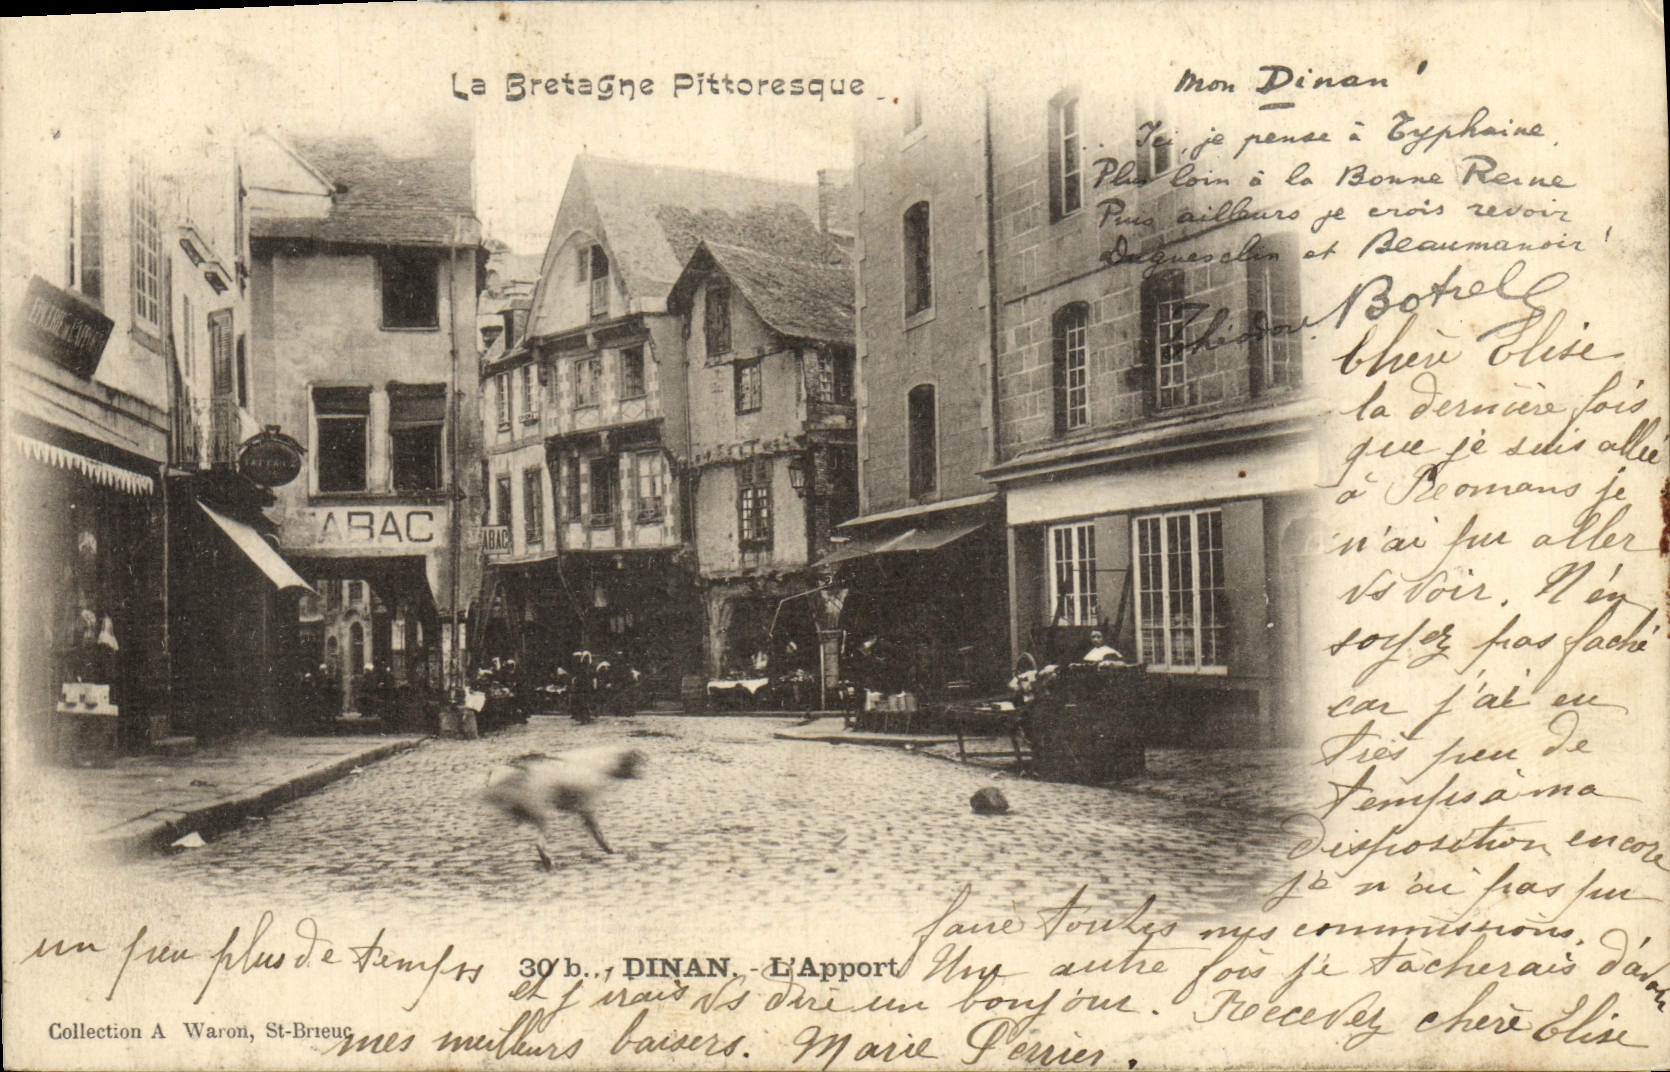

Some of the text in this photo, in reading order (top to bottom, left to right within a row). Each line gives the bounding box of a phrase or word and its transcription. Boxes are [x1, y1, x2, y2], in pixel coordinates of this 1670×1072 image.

[1174, 68, 1235, 93] Mon
[1190, 126, 1225, 160] je
[1233, 132, 1331, 159] pense
[1092, 156, 1148, 188] Plus
[1169, 162, 1230, 187] loin
[1285, 162, 1313, 186] la
[1335, 164, 1445, 187] Bonne
[1176, 196, 1300, 225] ailleurs
[1311, 207, 1346, 233] je
[1368, 199, 1444, 218] crois
[1466, 198, 1572, 222] revoir
[1302, 241, 1340, 260] et
[1340, 380, 1391, 421] la
[1555, 370, 1650, 440] fois
[1314, 438, 1432, 488] que
[1505, 428, 1586, 456] suis
[1574, 466, 1627, 528] je
[482, 529, 511, 550] ABAC
[1532, 503, 1662, 552] aller
[1455, 613, 1557, 675] pas
[1328, 695, 1407, 718] car
[1400, 738, 1518, 785] peu
[1543, 711, 1592, 757] de
[1524, 784, 1642, 804] ma
[1280, 812, 1670, 878] disposition encore
[1438, 862, 1566, 923] pas
[1526, 868, 1662, 923] pu
[20, 910, 485, 1012] un peu plus de temps
[1049, 945, 1205, 978] autre
[1171, 937, 1272, 1005] fois
[1269, 951, 1348, 1003] je
[850, 996, 928, 1013] un
[321, 1032, 416, 1057] mes
[432, 1008, 585, 1061] meilleurs
[793, 1025, 940, 1071] Marie
